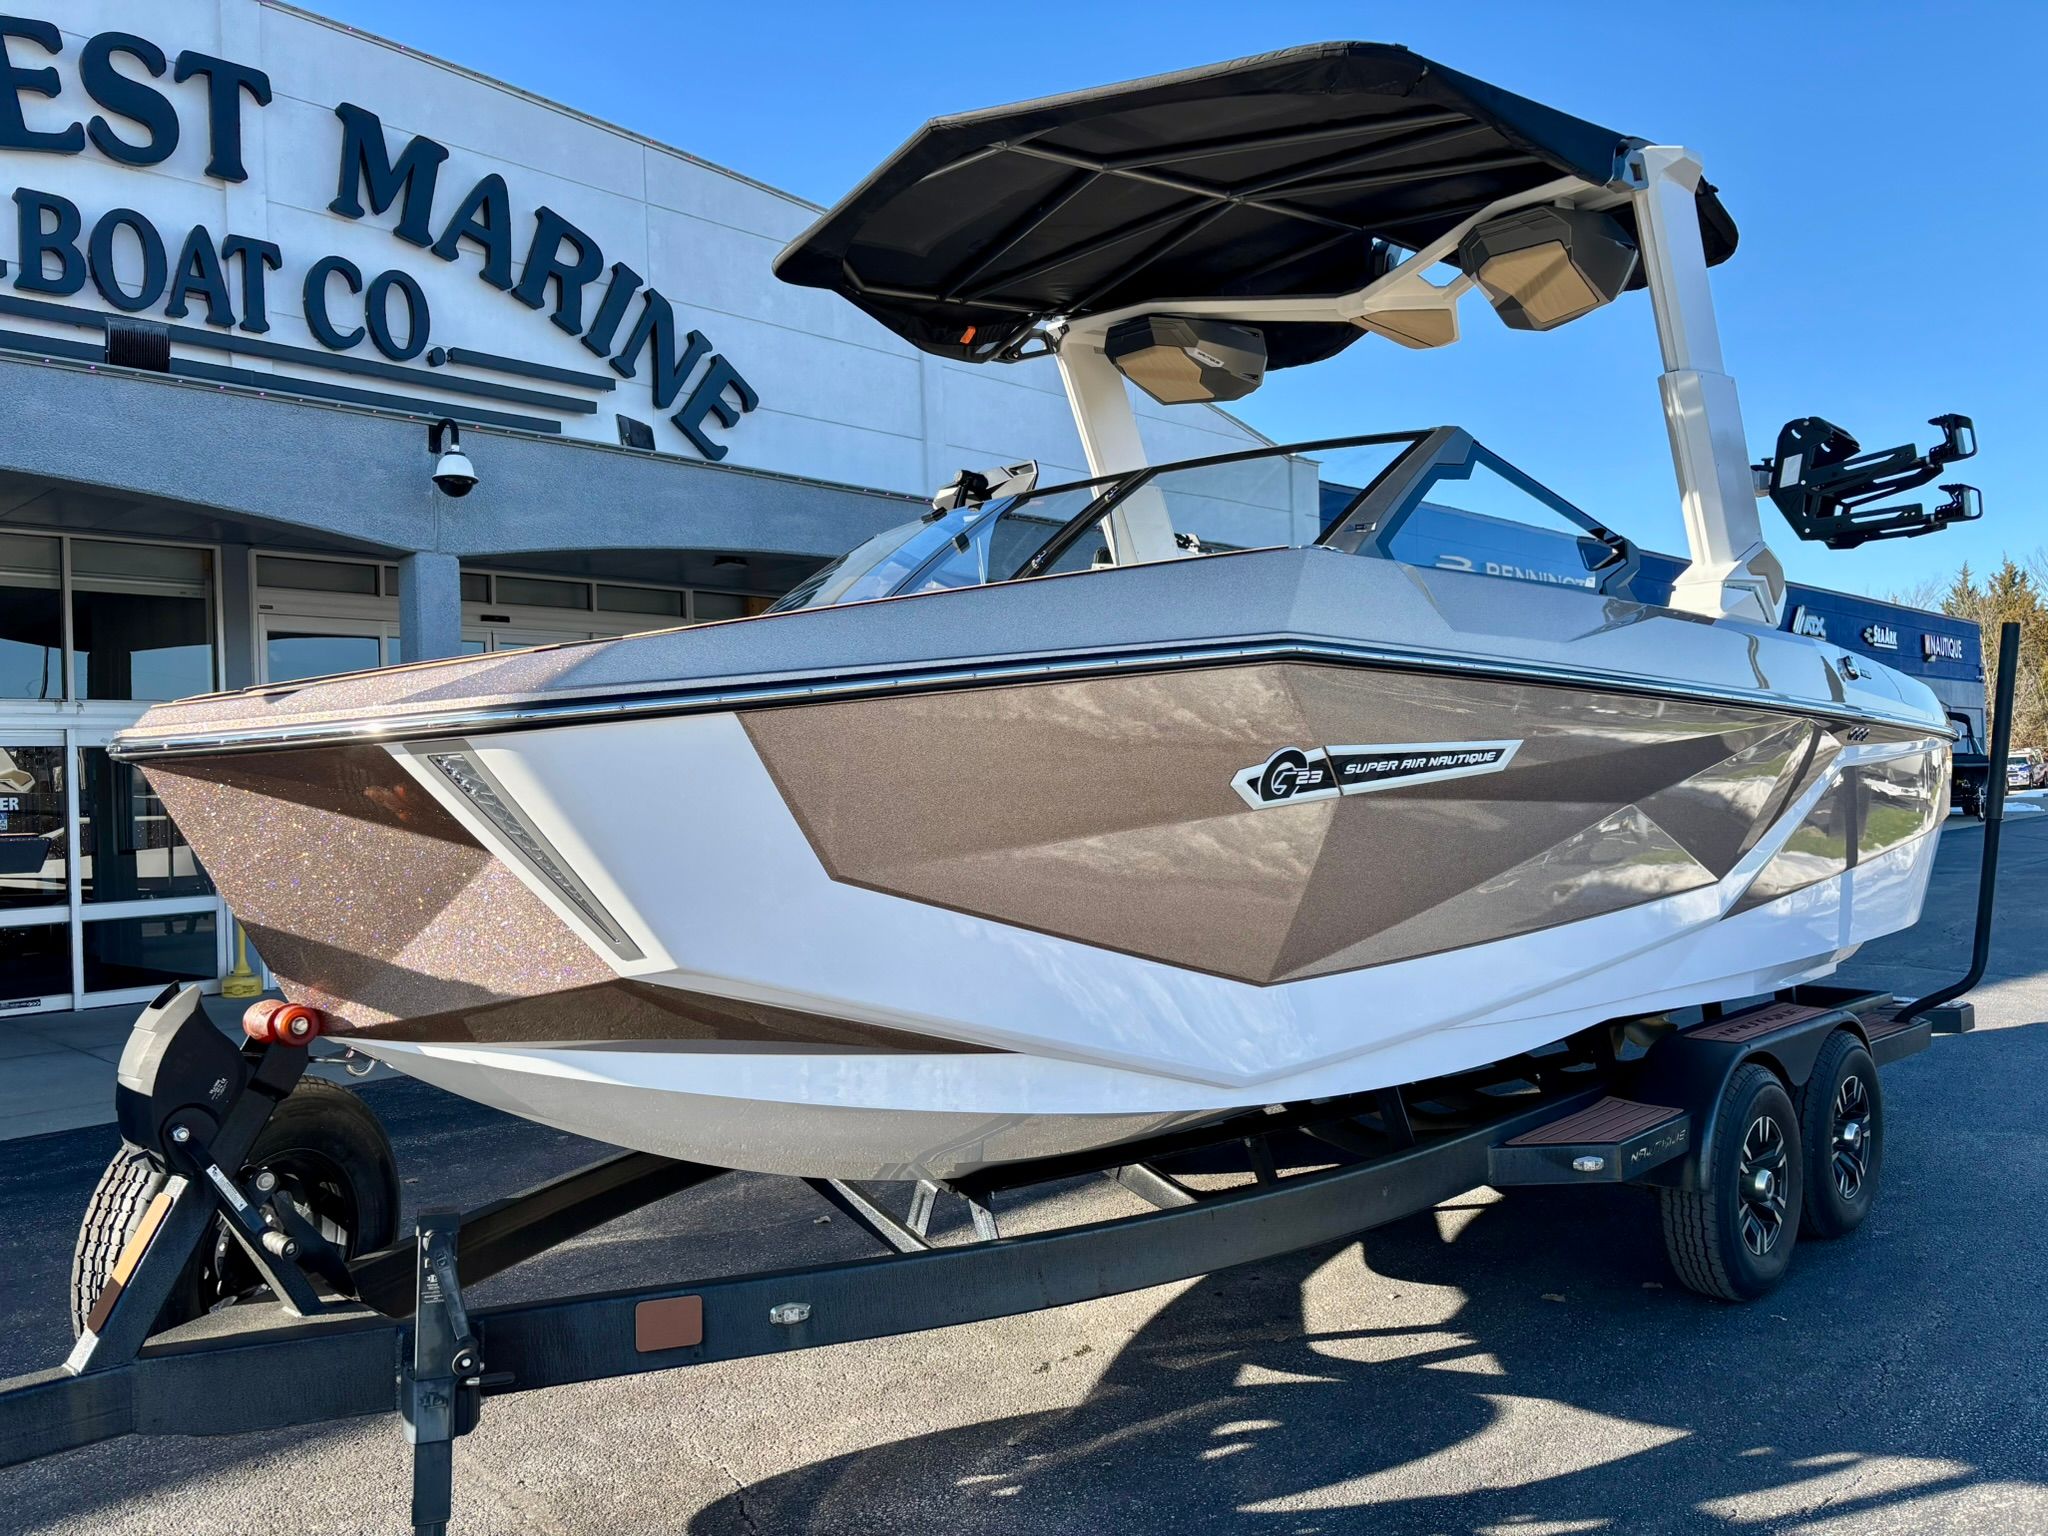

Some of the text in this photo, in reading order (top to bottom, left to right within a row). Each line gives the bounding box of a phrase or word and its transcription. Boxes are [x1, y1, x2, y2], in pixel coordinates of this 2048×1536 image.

[0, 15, 759, 461] EST MARINE
[12, 187, 446, 367] BOAT CO.
[1930, 636, 1962, 659] NAUTIQUE
[1344, 760, 1399, 775] SUPER
[1400, 757, 1427, 770] AIR
[1427, 751, 1497, 768] NAUTIQUE
